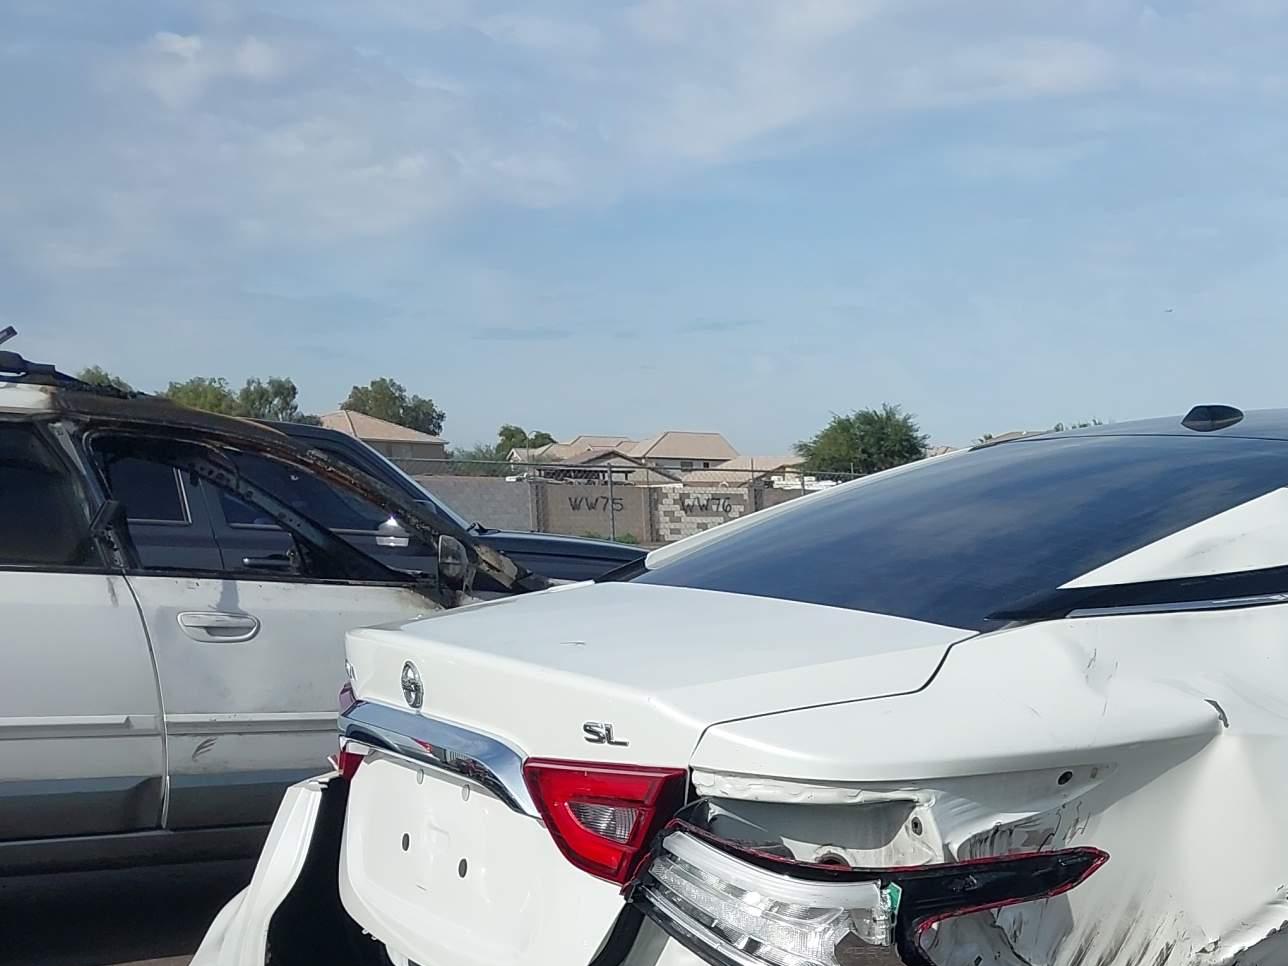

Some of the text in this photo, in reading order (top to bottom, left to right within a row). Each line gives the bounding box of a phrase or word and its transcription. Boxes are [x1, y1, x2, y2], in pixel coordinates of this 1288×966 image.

[568, 496, 624, 512] WW75
[681, 497, 732, 514] WW76
[583, 721, 629, 747] SL
